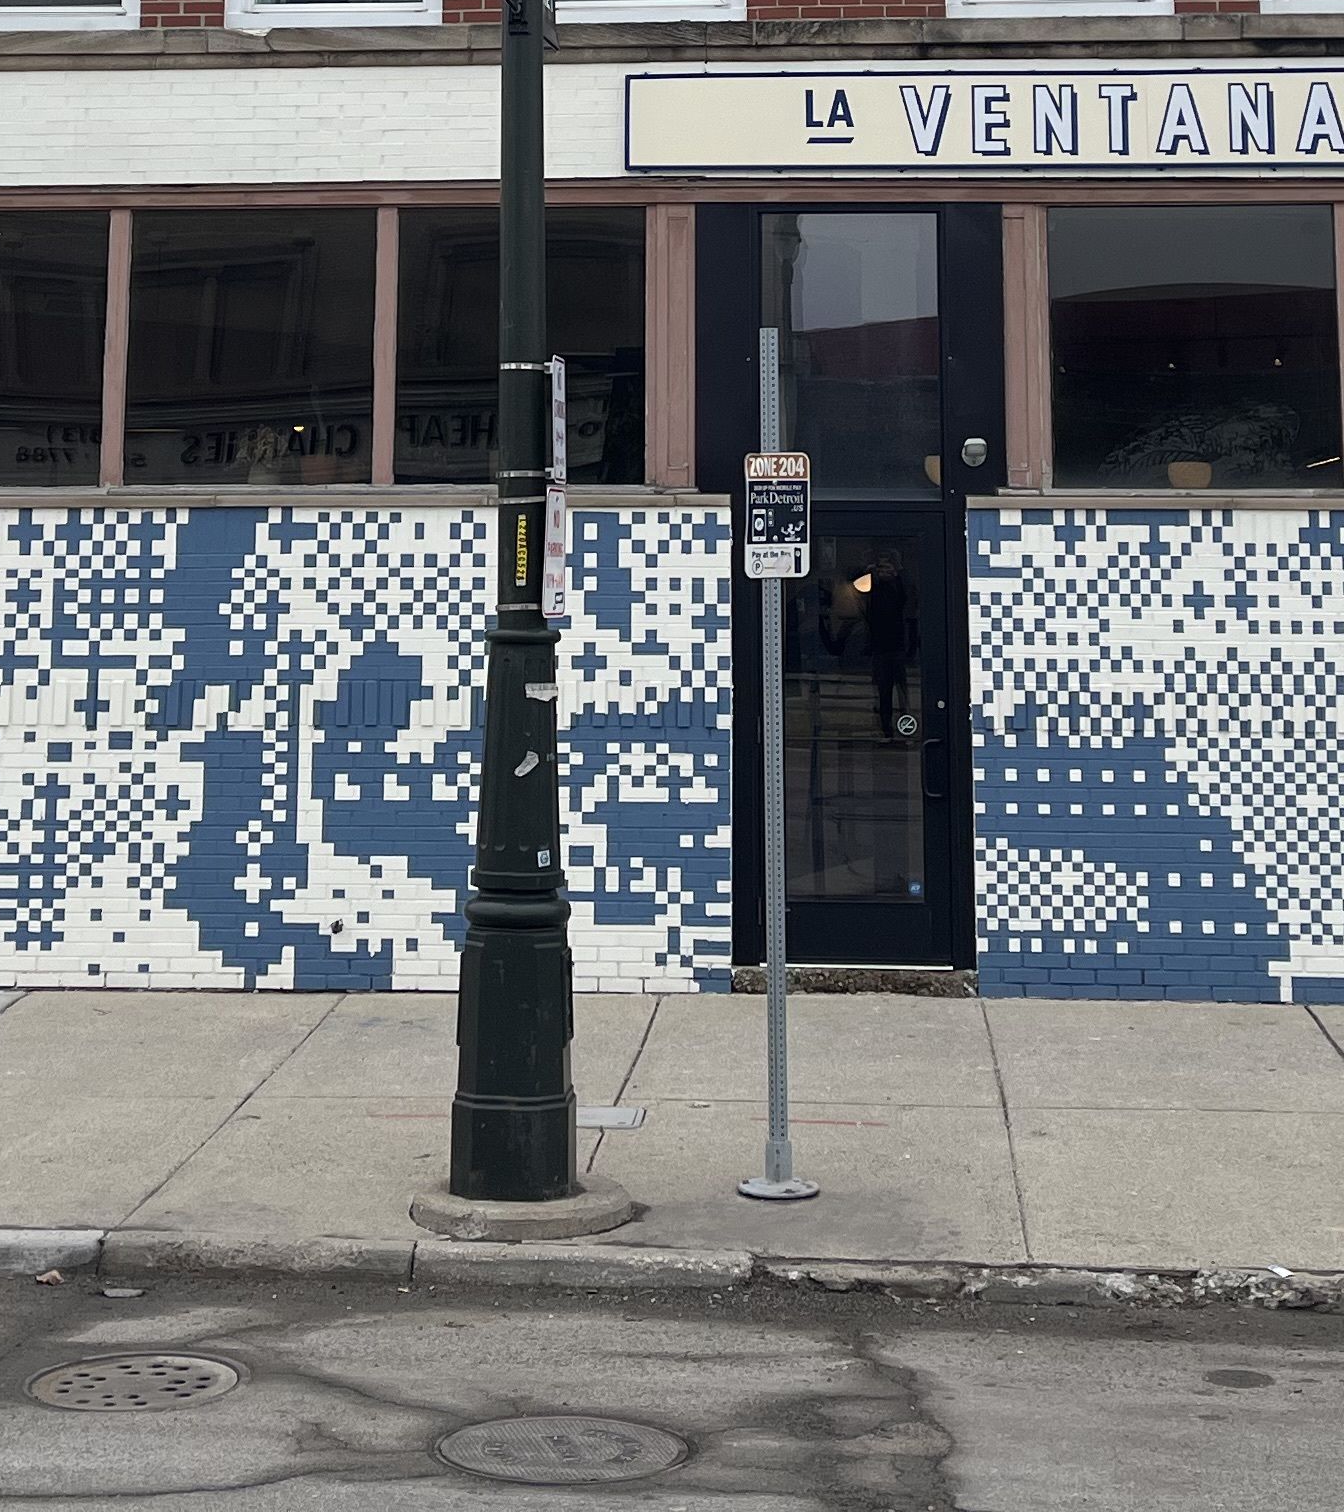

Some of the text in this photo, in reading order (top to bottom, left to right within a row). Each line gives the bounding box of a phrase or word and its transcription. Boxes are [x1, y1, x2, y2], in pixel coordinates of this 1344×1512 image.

[805, 89, 854, 128] LA
[749, 457, 805, 477] ZONE 204
